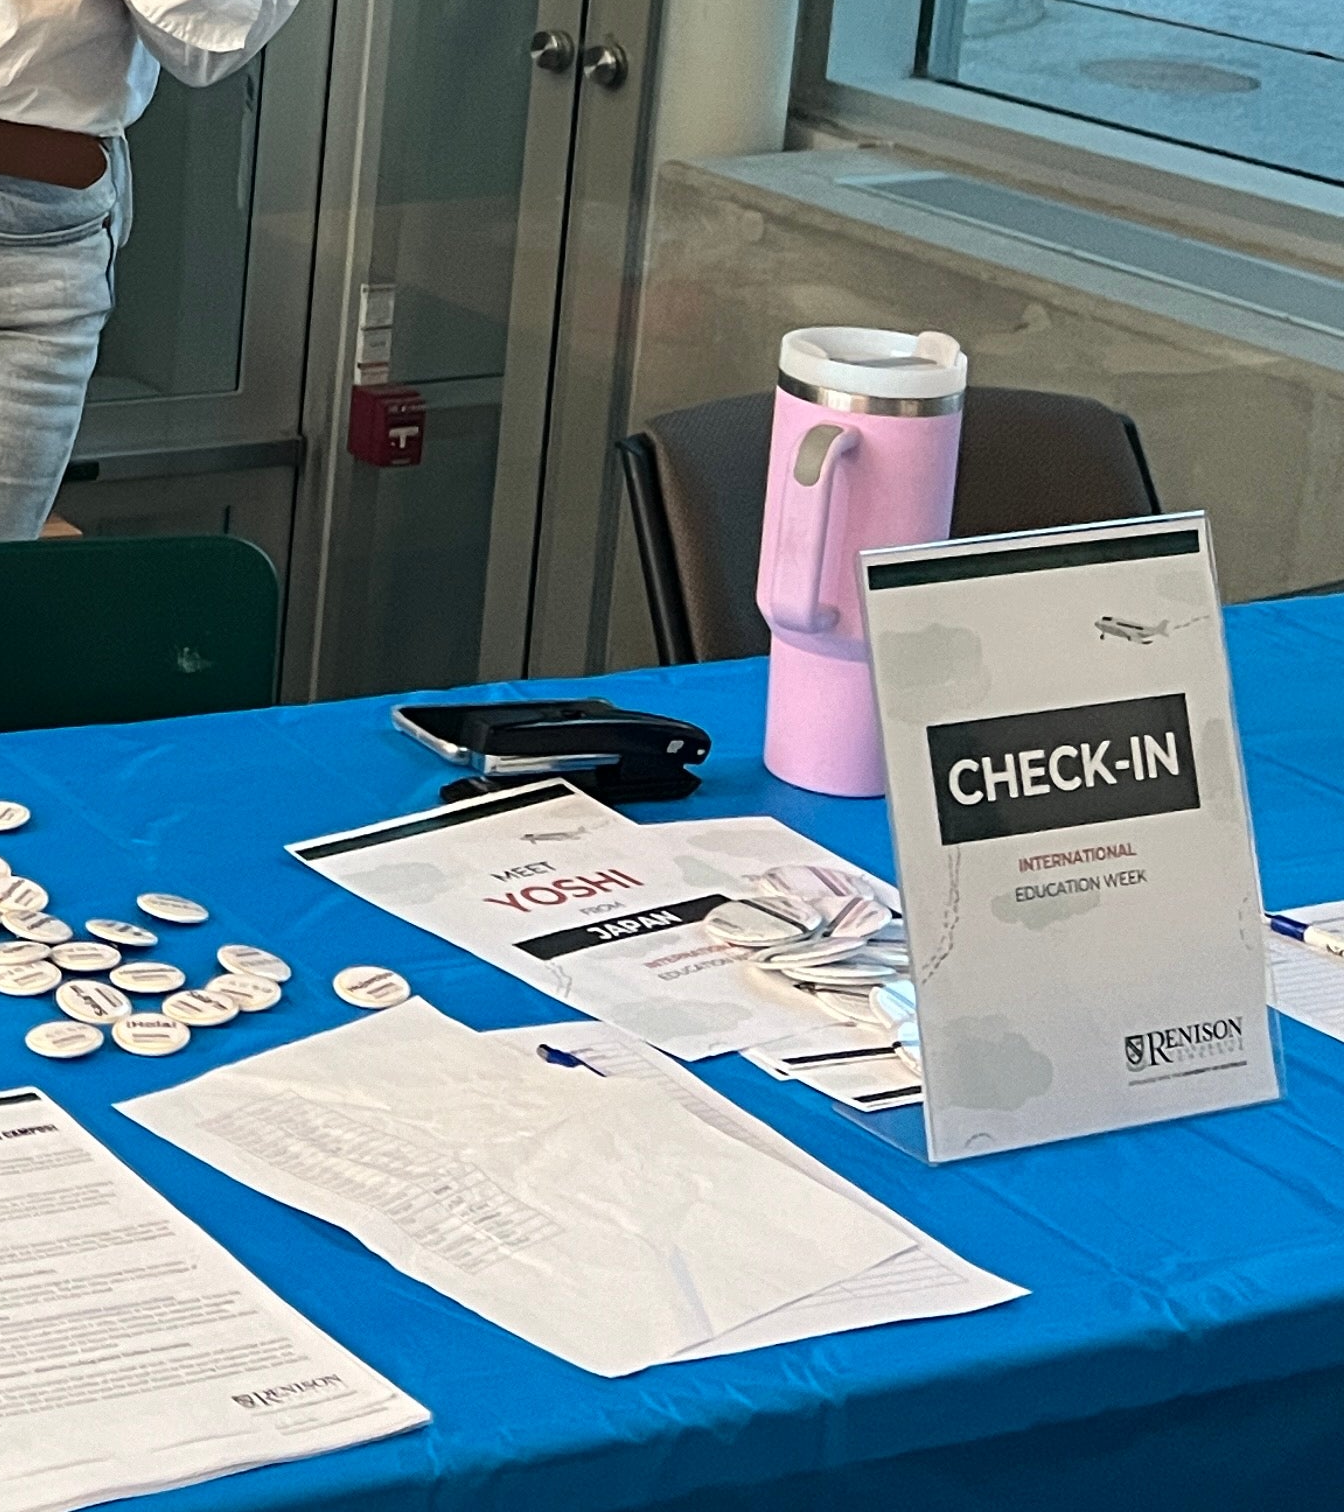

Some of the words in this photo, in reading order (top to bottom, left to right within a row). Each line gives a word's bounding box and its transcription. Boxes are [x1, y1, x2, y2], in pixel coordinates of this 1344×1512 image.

[947, 730, 1181, 806] CHECK-IN
[490, 859, 558, 883] MEET
[1017, 842, 1139, 874] INTERNATIONAL
[482, 868, 646, 914] YOSHI
[1014, 874, 1102, 904] EDUCATION
[1104, 868, 1149, 889] WEEK
[578, 899, 628, 917] FROM
[585, 909, 685, 941] JAPAN
[1146, 1015, 1244, 1067] RENISON
